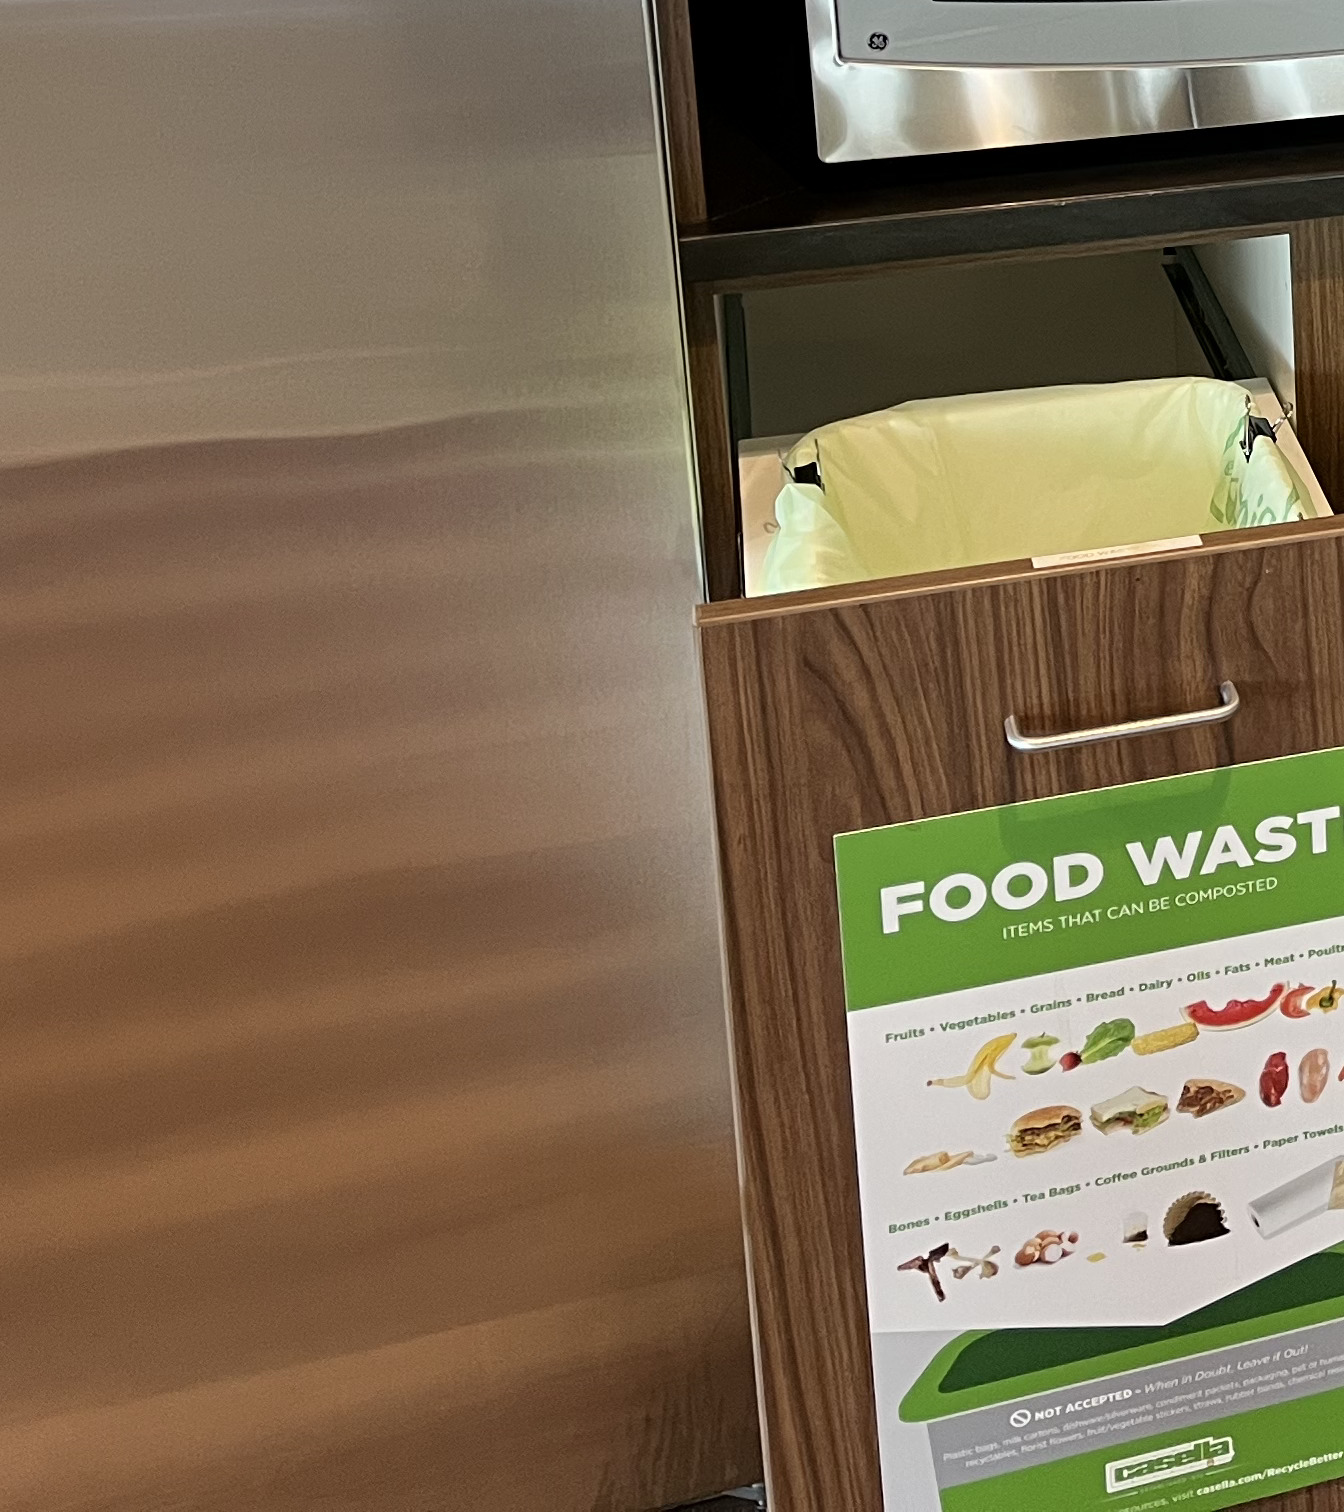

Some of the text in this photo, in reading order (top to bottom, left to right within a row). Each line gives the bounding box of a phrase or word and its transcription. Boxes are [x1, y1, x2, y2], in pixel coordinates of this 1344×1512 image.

[879, 852, 1104, 935] FOOD
[1002, 876, 1278, 941] ITEMS THAT CAN BE COMPOSTED
[885, 1027, 925, 1044] Fruits
[939, 1008, 1016, 1032] Vegetables
[1030, 997, 1073, 1014] Grains
[1086, 986, 1125, 1003] Bread
[1138, 977, 1174, 993] Dairy
[1186, 970, 1211, 983] Oils
[1224, 962, 1251, 976] Fats
[1264, 953, 1295, 968] Meat
[888, 1217, 930, 1234] Bones
[944, 1199, 1009, 1222] Eggshells
[1022, 1191, 1046, 1204] Tea
[1049, 1182, 1082, 1198] Bags
[1094, 1170, 1138, 1187] Coffee
[1141, 1156, 1195, 1177] Grounds
[1210, 1145, 1250, 1162] Filters
[1262, 1134, 1299, 1150] Paper
[1302, 1124, 1344, 1140] Towels
[1034, 1406, 1063, 1421] NOT
[1065, 1389, 1133, 1414] ACCEPTED
[1144, 1378, 1179, 1395] When
[1237, 1355, 1271, 1371] Leave
[1283, 1344, 1309, 1359] Out!
[1172, 1489, 1195, 1503] visit
[1196, 1450, 1344, 1497] casella.com/RecycleBetter
